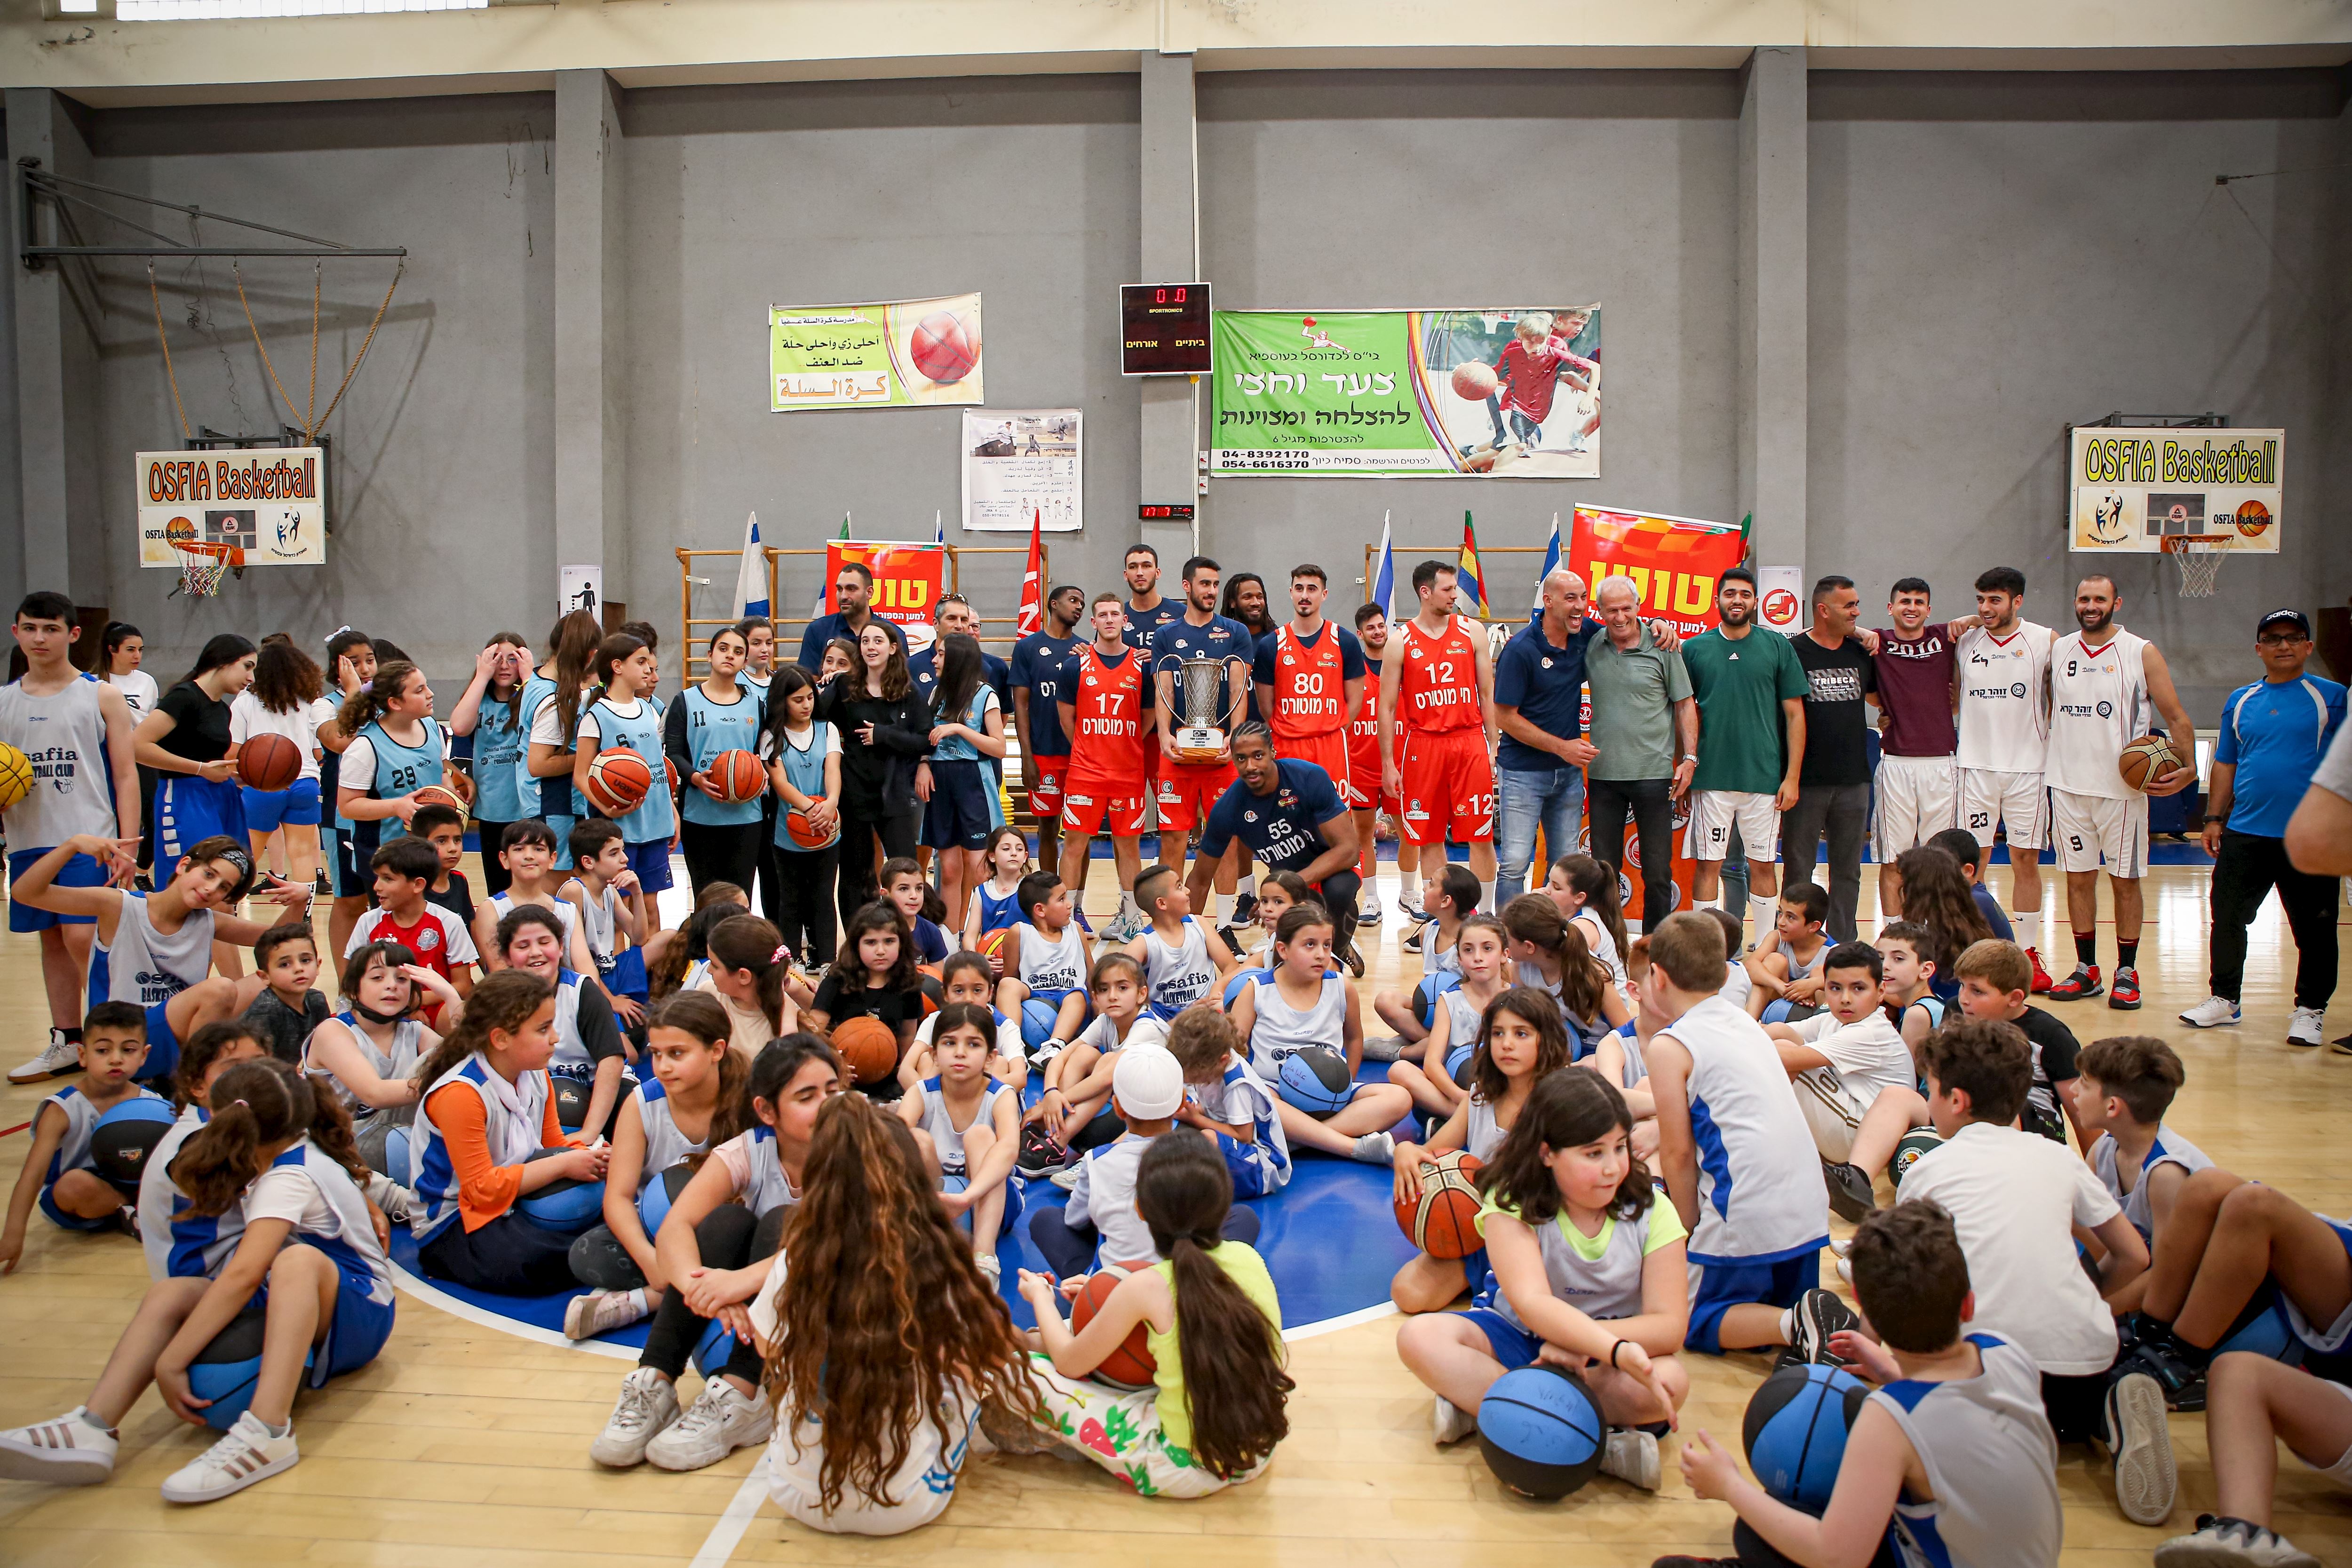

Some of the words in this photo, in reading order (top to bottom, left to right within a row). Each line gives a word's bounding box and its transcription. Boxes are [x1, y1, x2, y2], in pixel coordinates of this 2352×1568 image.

[806, 337, 837, 351] وأحلى
[838, 338, 851, 350] زي
[853, 335, 879, 350] أحلى
[842, 356, 863, 365] ضد
[1300, 350, 1349, 360] לכדורסל
[779, 378, 842, 398] السلة
[845, 375, 886, 401] كرة
[1234, 371, 1307, 396] וחצי
[1321, 371, 1396, 397] צעד
[1220, 410, 1306, 426] ומצוינות
[1315, 400, 1411, 426] להצלחה
[1281, 434, 1306, 444] מגיל
[1309, 434, 1364, 443] להצטרפות
[1312, 457, 1331, 466] כיוף
[2086, 439, 2156, 482] OSFIA
[2163, 440, 2276, 484] Basketball
[149, 461, 211, 502] OSFIA
[216, 458, 316, 501] Basketball
[2214, 514, 2235, 524] OSFIA
[2236, 514, 2273, 525] Basketball
[145, 529, 166, 539] OSFIA
[166, 529, 199, 539] Basketball
[906, 611, 926, 621] למען
[2266, 610, 2298, 621] adidas
[1679, 621, 1708, 634] למען
[1136, 631, 1155, 646] 15
[1425, 662, 1454, 685] 12
[2067, 660, 2077, 677] 9
[1294, 673, 1324, 695] 80
[1814, 676, 1855, 685] TRIBECA
[1414, 687, 1457, 710] מוטורס
[1460, 687, 1471, 704] חי
[1970, 688, 1986, 698] קרא
[1096, 693, 1125, 715] 17
[1281, 697, 1322, 715] מוטורס
[1326, 698, 1337, 715] חי
[2060, 705, 2073, 715] קרא
[477, 712, 494, 730] 14
[693, 710, 706, 727] 11
[1082, 718, 1123, 736] מוטורס
[1127, 720, 1136, 737] חי
[56, 764, 75, 777] CLUB
[391, 765, 416, 789] 29
[1469, 794, 1493, 815] 12
[1970, 812, 1988, 828] 23
[1268, 818, 1292, 840] 55
[1711, 827, 1726, 843] 91
[1256, 835, 1305, 863] מוטורס
[2070, 835, 2083, 852] 9
[1162, 988, 1200, 1004] BASKETBALL
